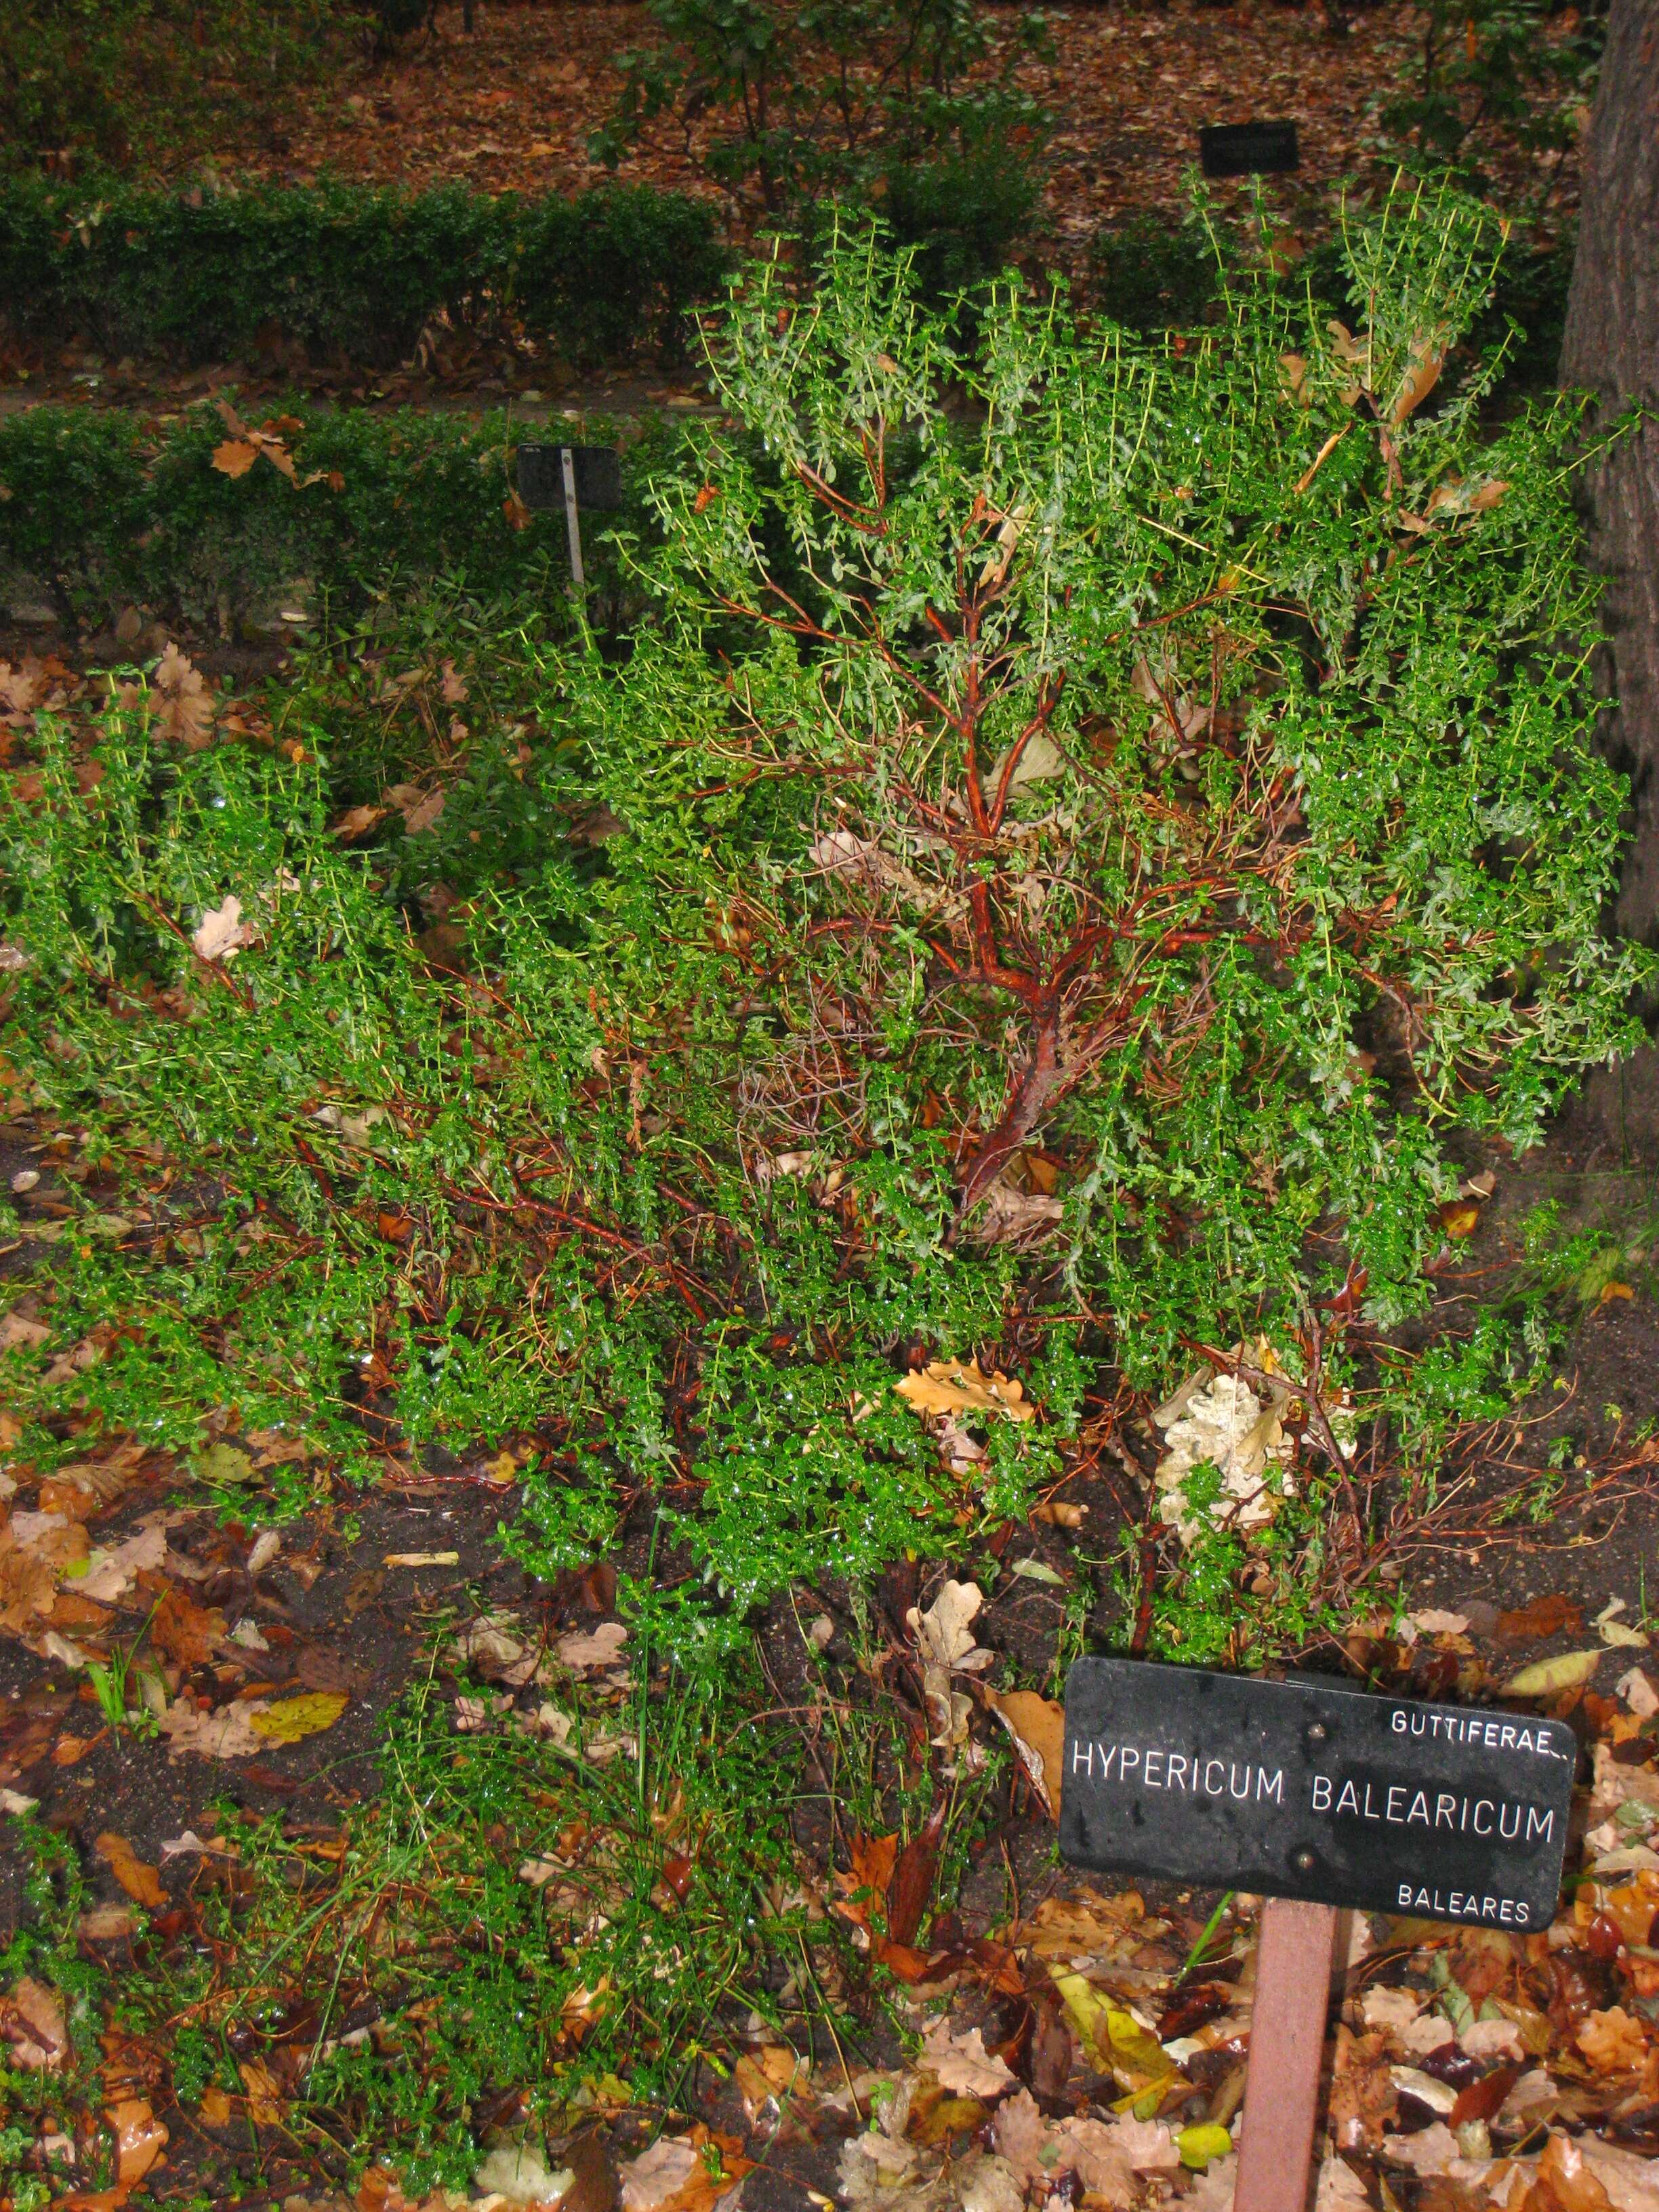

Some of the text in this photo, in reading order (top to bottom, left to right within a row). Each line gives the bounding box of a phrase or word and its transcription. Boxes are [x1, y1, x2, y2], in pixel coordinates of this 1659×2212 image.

[1391, 1710, 1553, 1754] GUTTIFERAE
[1073, 1740, 1555, 1843] HYPERICUM BALEARICUM
[1397, 1885, 1530, 1923] BALEARES
